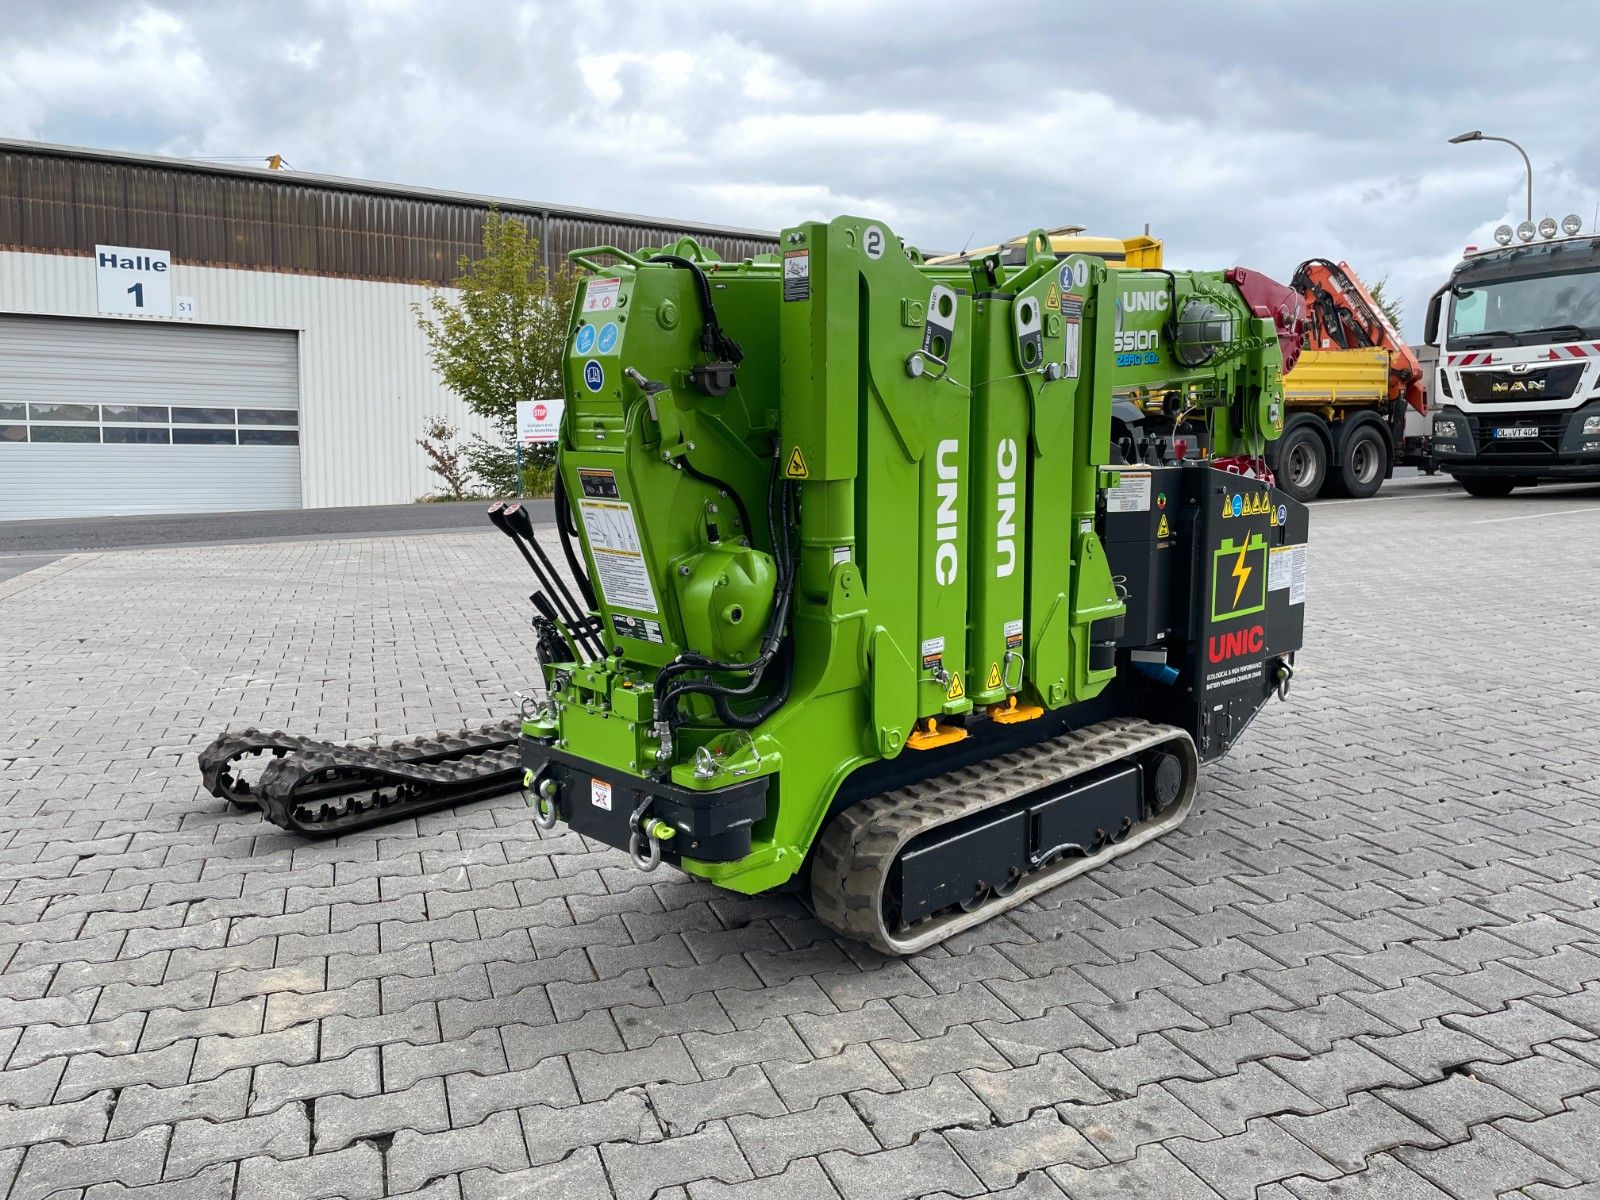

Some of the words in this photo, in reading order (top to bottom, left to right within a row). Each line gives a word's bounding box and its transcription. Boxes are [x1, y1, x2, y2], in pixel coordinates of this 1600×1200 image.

[868, 231, 880, 255] 2
[99, 252, 168, 272] Halle
[1077, 263, 1083, 283] 1
[127, 282, 144, 308] 1
[1123, 290, 1168, 312] UNIC
[1492, 380, 1545, 392] MAN
[534, 409, 546, 417] STOP
[936, 439, 958, 586] UNIC
[996, 438, 1017, 578] UNIC
[1209, 625, 1264, 663] UNIC
